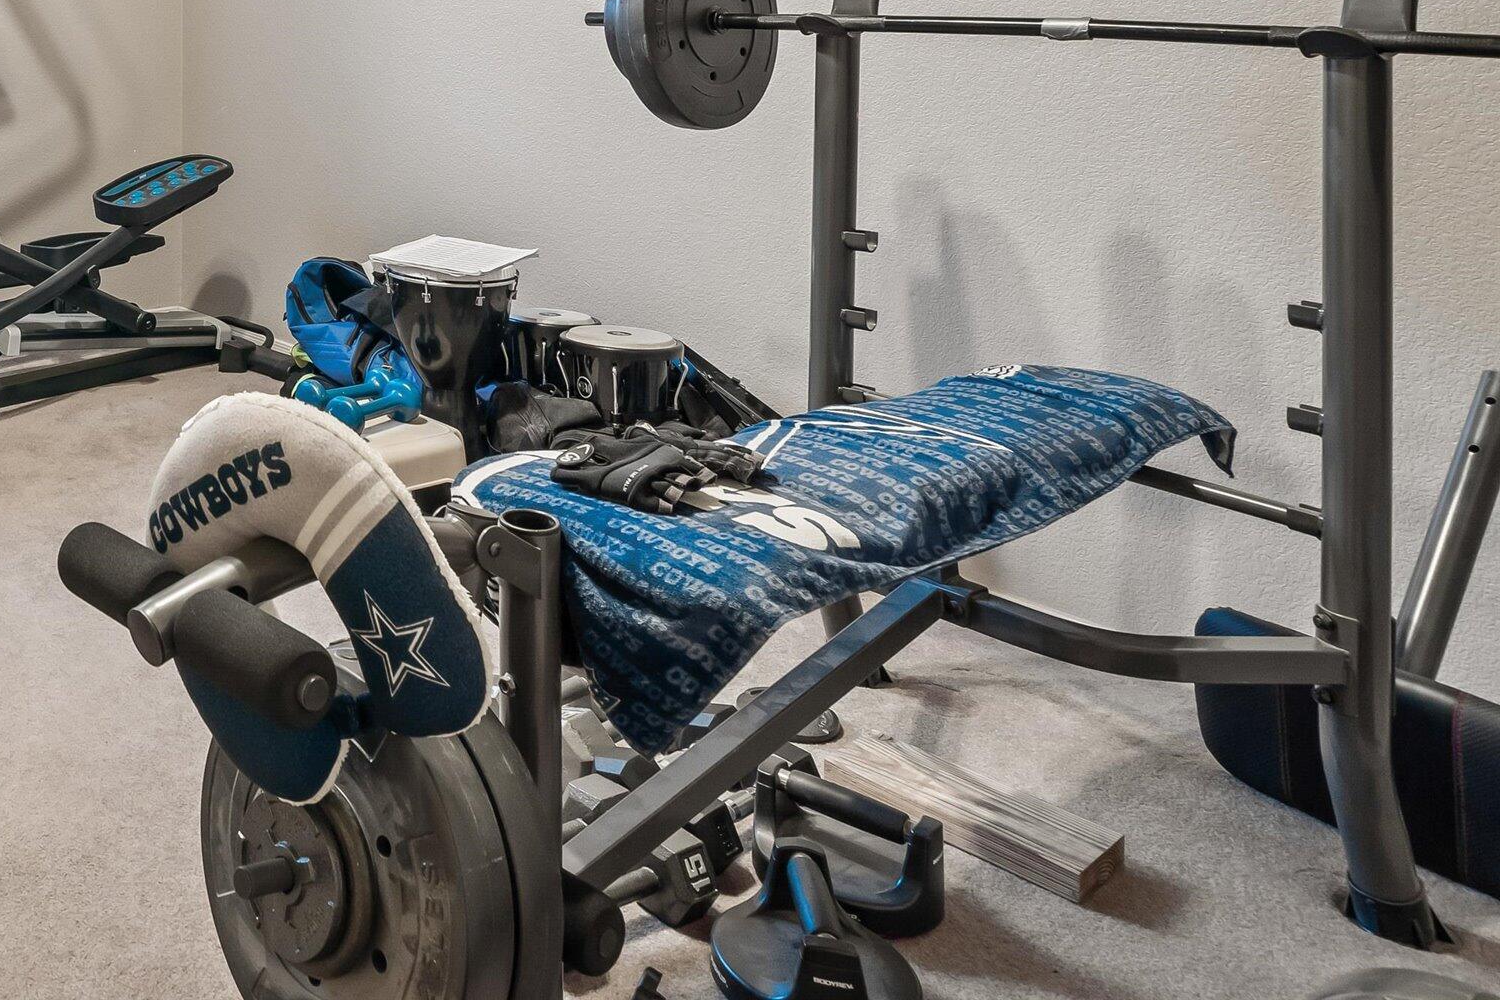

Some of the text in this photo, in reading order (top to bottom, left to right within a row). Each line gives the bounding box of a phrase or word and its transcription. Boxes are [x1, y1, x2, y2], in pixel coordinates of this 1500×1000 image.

[149, 441, 292, 554] COWBOYS
[799, 472, 909, 531] COWBOYS
[607, 517, 722, 575] COWBOYS
[684, 853, 712, 892] 15
